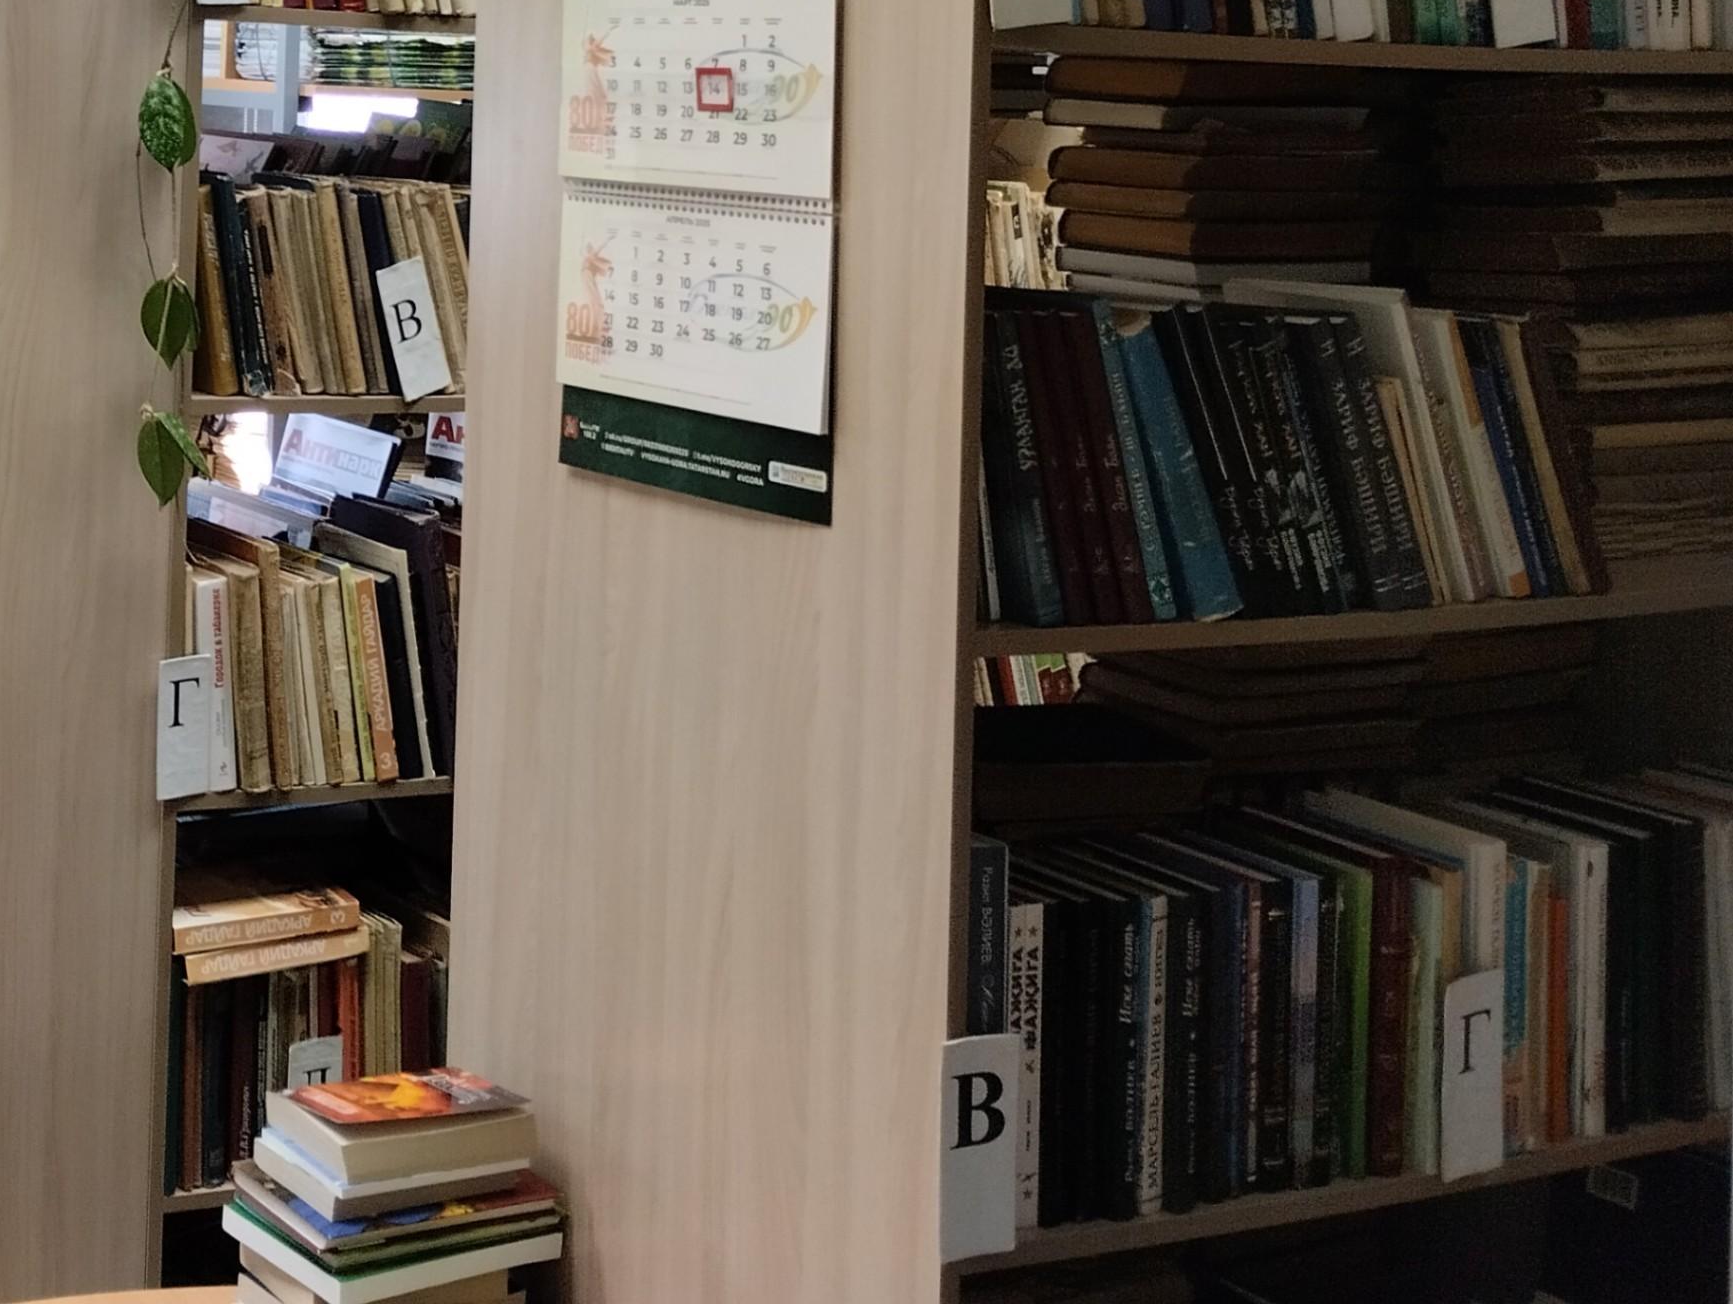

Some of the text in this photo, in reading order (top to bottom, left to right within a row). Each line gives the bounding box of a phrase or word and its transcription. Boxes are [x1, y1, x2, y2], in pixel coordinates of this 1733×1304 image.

[742, 35, 776, 48] 1 2
[634, 248, 771, 275] 1 2 3 4 5 6
[607, 267, 772, 300] 7 8 9 10 11 12 13
[391, 299, 422, 343] В
[604, 290, 772, 324] 14 15 16 17 18 19 20
[602, 336, 663, 357] 28 29 30
[604, 314, 771, 350] 21 22 23 24 25 26 27
[360, 594, 391, 769] 3 АРКАДИЙ ГАЙДАР
[168, 677, 200, 727] Г
[185, 924, 240, 944] ГАЙДАР
[245, 914, 312, 937] АРКАДИЙ
[200, 940, 325, 974] АРКАДИЙ ГАЙДАР
[1011, 947, 1024, 1034] АҖИГА
[1459, 1008, 1491, 1075] Г
[951, 1072, 1005, 1150] В
